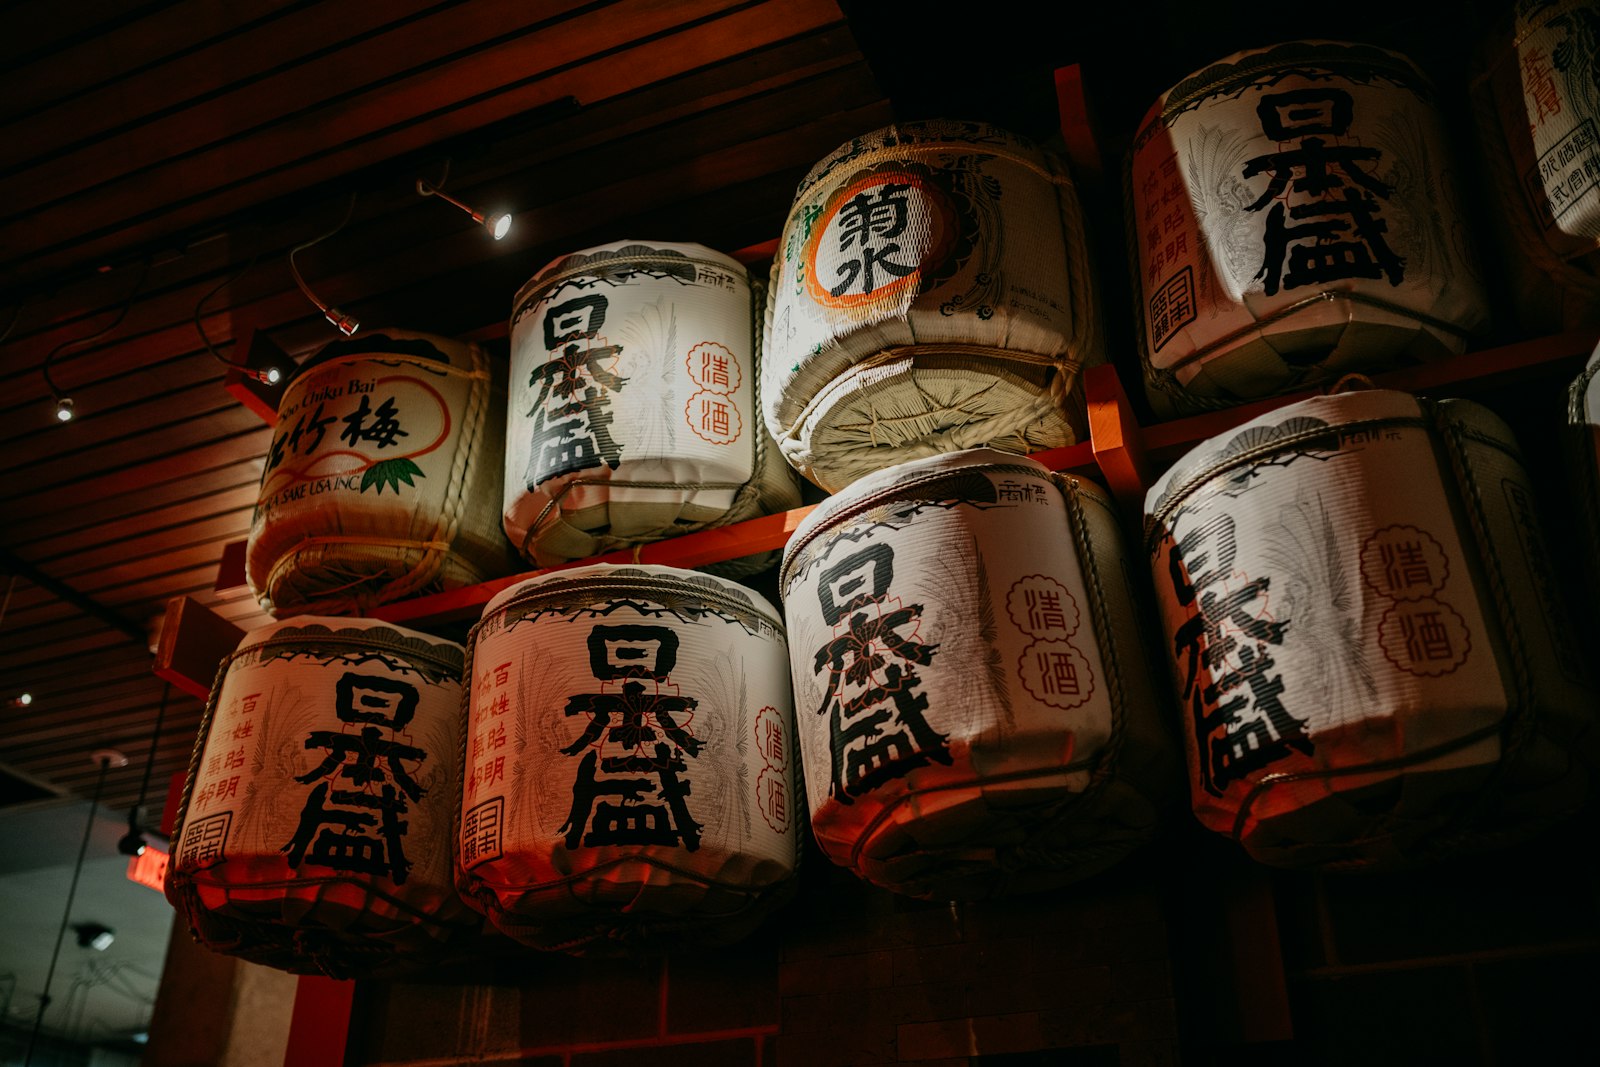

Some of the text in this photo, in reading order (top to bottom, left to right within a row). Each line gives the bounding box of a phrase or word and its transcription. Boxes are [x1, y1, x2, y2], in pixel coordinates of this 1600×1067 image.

[830, 183, 921, 298] 菊水
[1242, 89, 1408, 297] 日本盛
[302, 386, 343, 408] Chiku
[347, 377, 376, 395] Bai
[527, 293, 630, 493] 日本盛
[702, 351, 730, 436] 清酒
[281, 483, 307, 505] SAKE
[308, 478, 331, 496] USA
[998, 480, 1049, 506] 商標
[1025, 589, 1080, 696] 清酒
[1169, 513, 1315, 798] 日本盛
[1379, 541, 1453, 662] 清酒
[814, 542, 954, 805] 日本盛
[279, 672, 429, 886] 日本盛
[557, 624, 708, 853] 日本盛
[765, 718, 786, 823] 清酒
